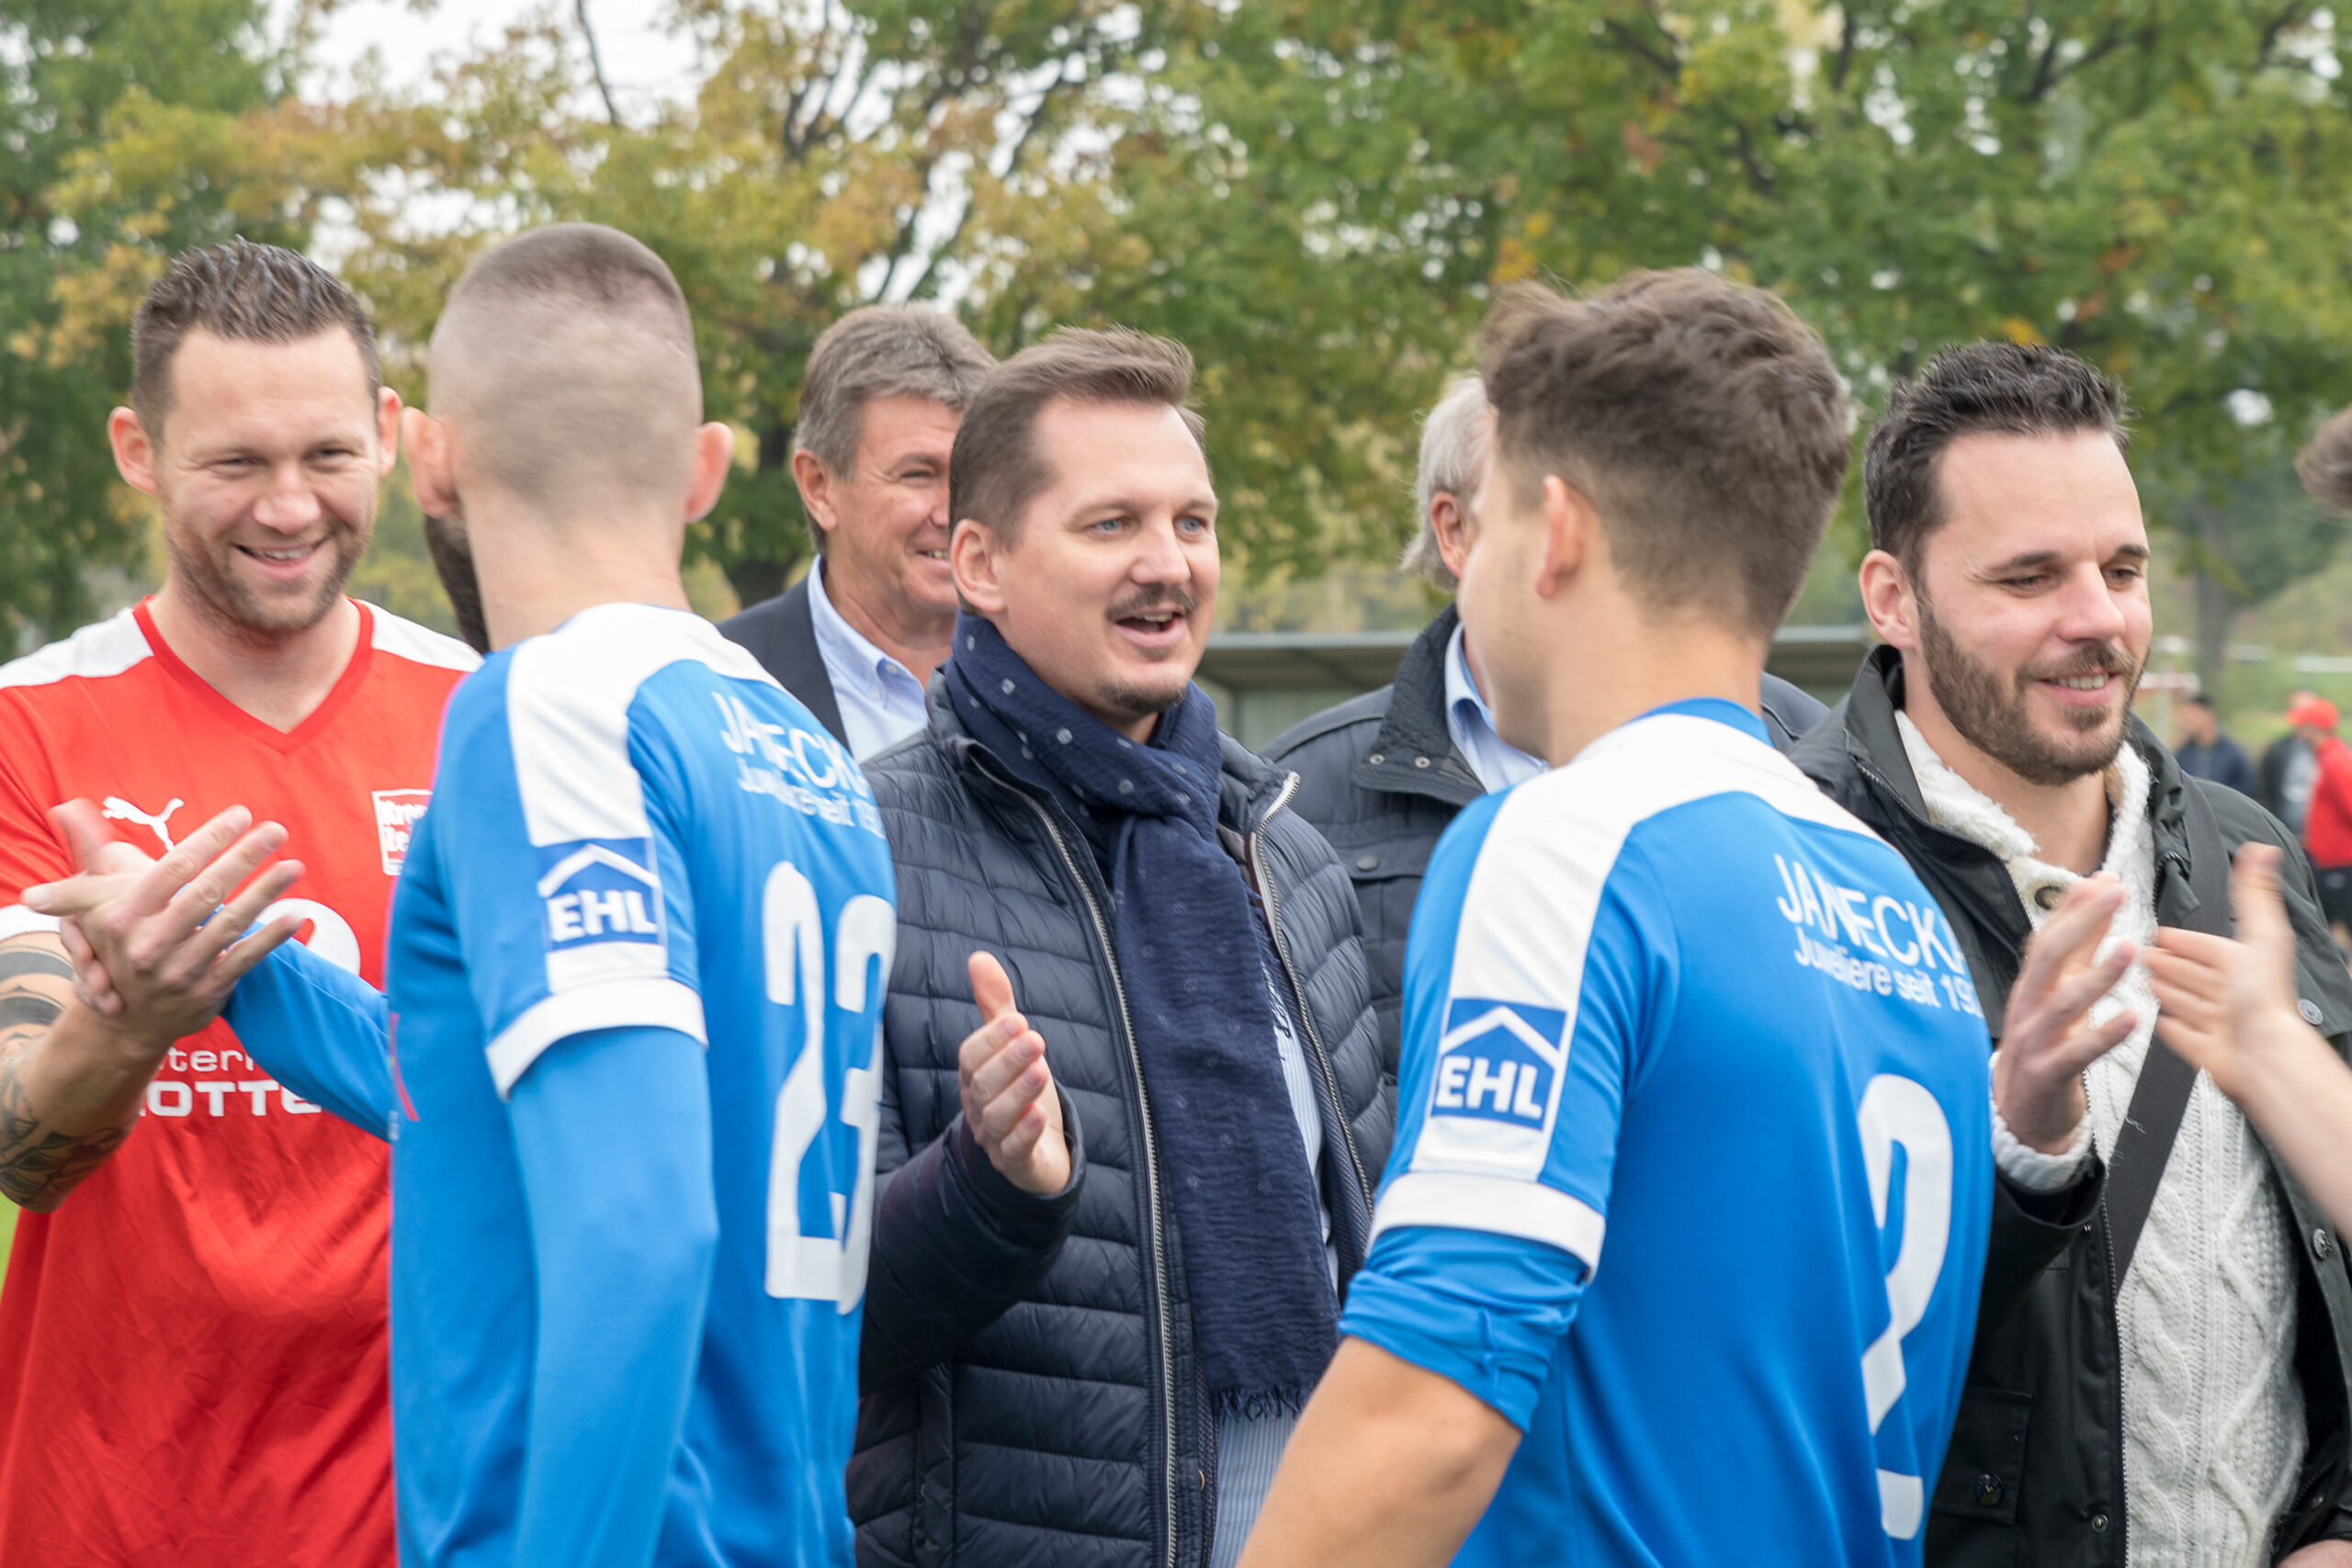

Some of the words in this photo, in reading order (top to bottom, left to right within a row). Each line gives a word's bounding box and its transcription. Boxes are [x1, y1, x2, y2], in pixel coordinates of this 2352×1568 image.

[548, 889, 657, 942] EHL
[139, 1079, 322, 1117] OTTE
[763, 861, 897, 1315] 23
[1435, 1056, 1543, 1120] EHL
[1858, 1073, 1953, 1540] 2
